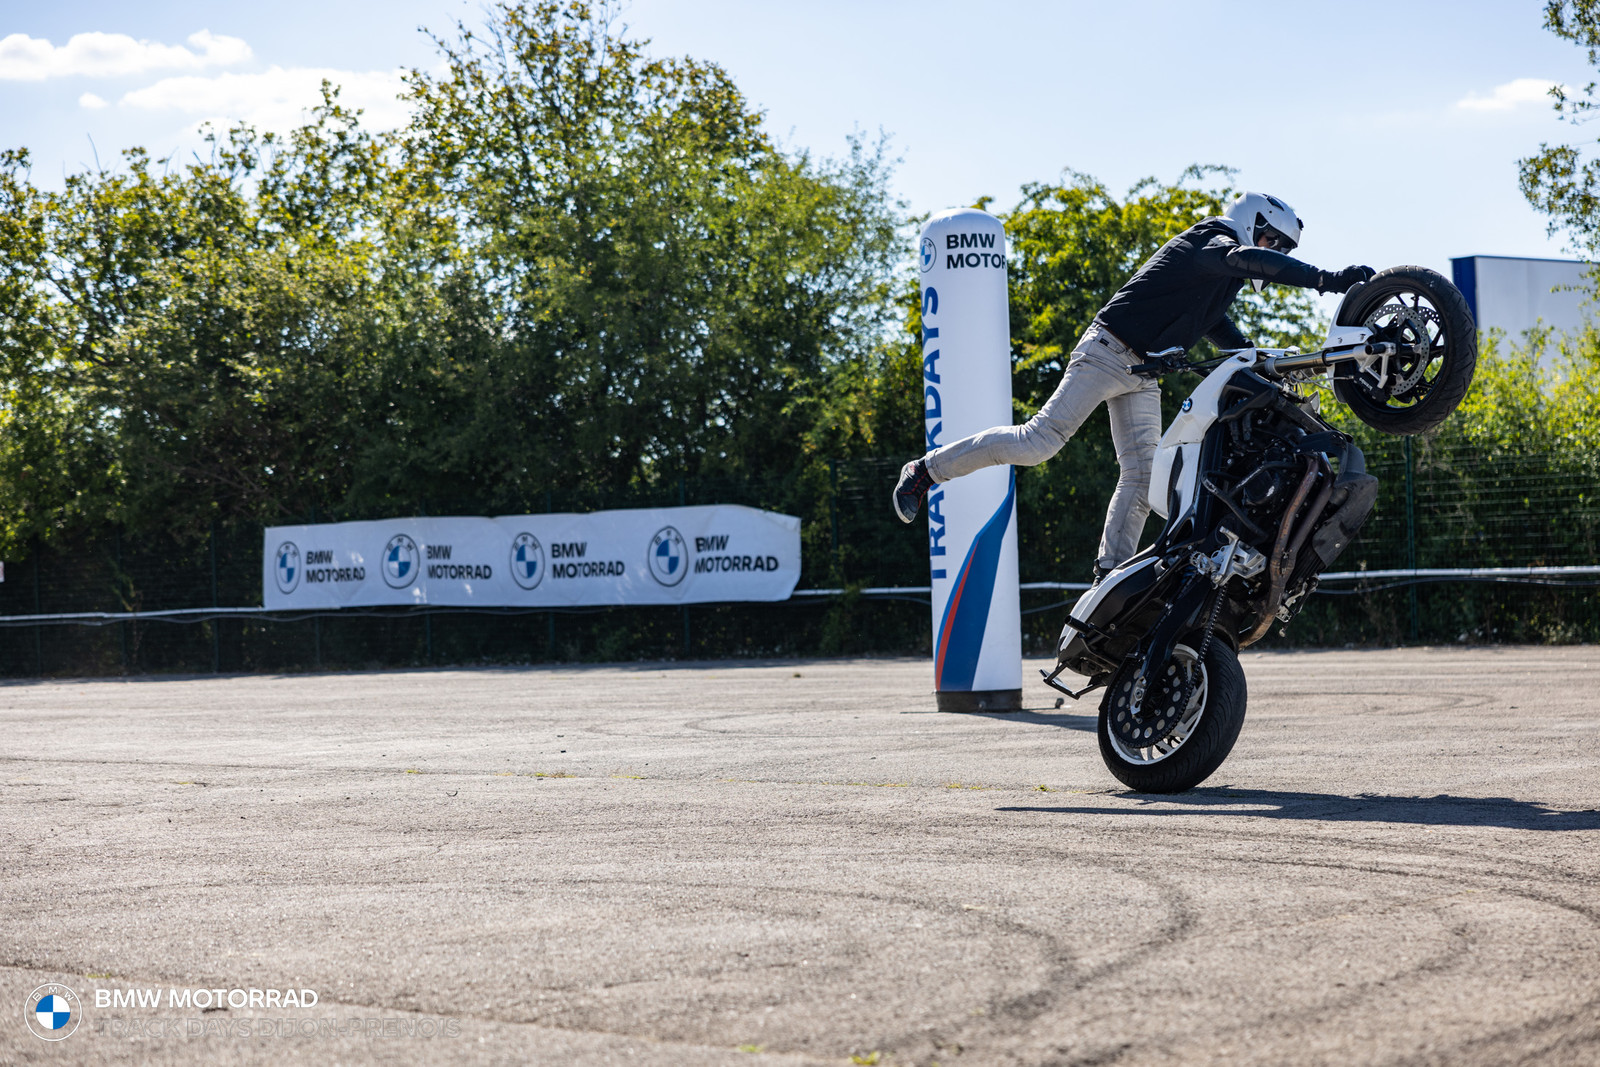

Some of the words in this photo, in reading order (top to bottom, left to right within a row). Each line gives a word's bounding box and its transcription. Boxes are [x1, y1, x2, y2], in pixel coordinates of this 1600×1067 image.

[946, 233, 996, 249] BMW
[921, 285, 948, 590] TRAKDAYS
[427, 545, 452, 560] BMW
[551, 542, 588, 559] BMW
[695, 535, 730, 553] BMW
[306, 550, 334, 565] BMW
[694, 556, 779, 574] MOTORRAD
[427, 565, 493, 580] MOTORRAD
[552, 560, 625, 579] MOTORRAD
